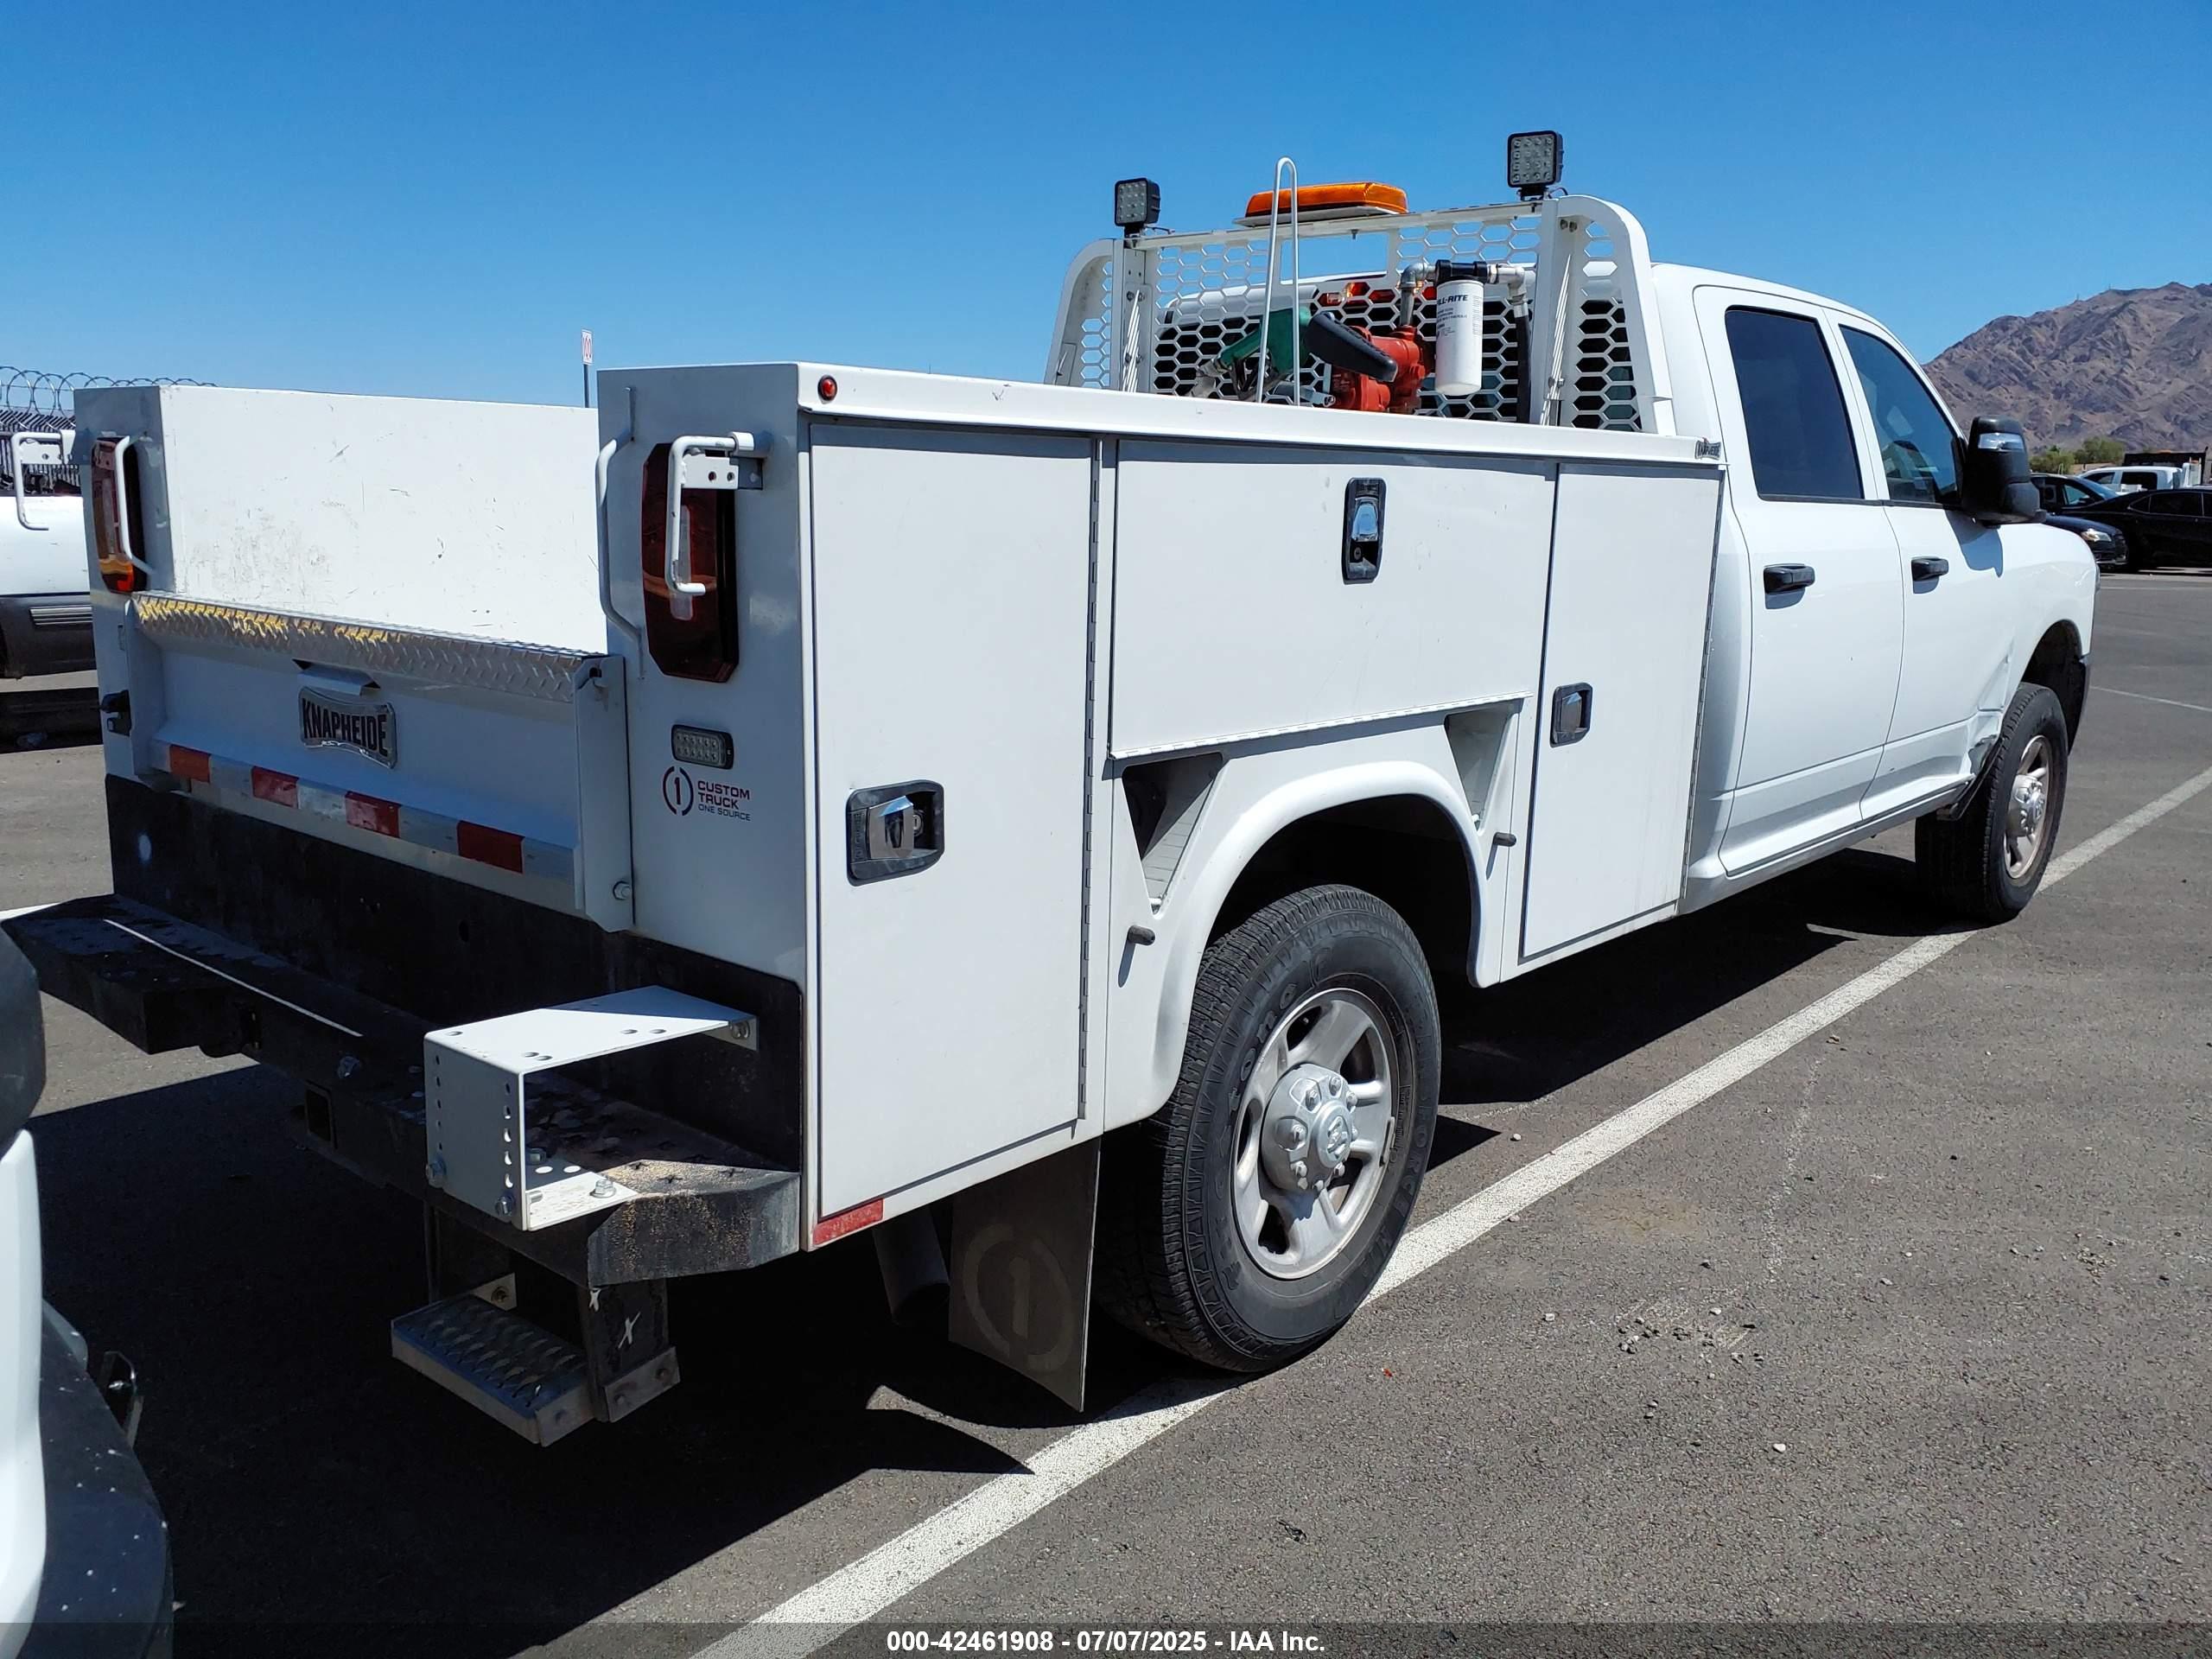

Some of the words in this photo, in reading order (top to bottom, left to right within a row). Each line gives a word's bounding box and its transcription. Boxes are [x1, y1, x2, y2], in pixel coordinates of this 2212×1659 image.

[302, 697, 388, 757] KNAPHEIDE
[697, 780, 750, 800] CUSTOM
[698, 792, 739, 810] TRUCK
[698, 804, 715, 814] ONE
[717, 808, 751, 821] SOURCE
